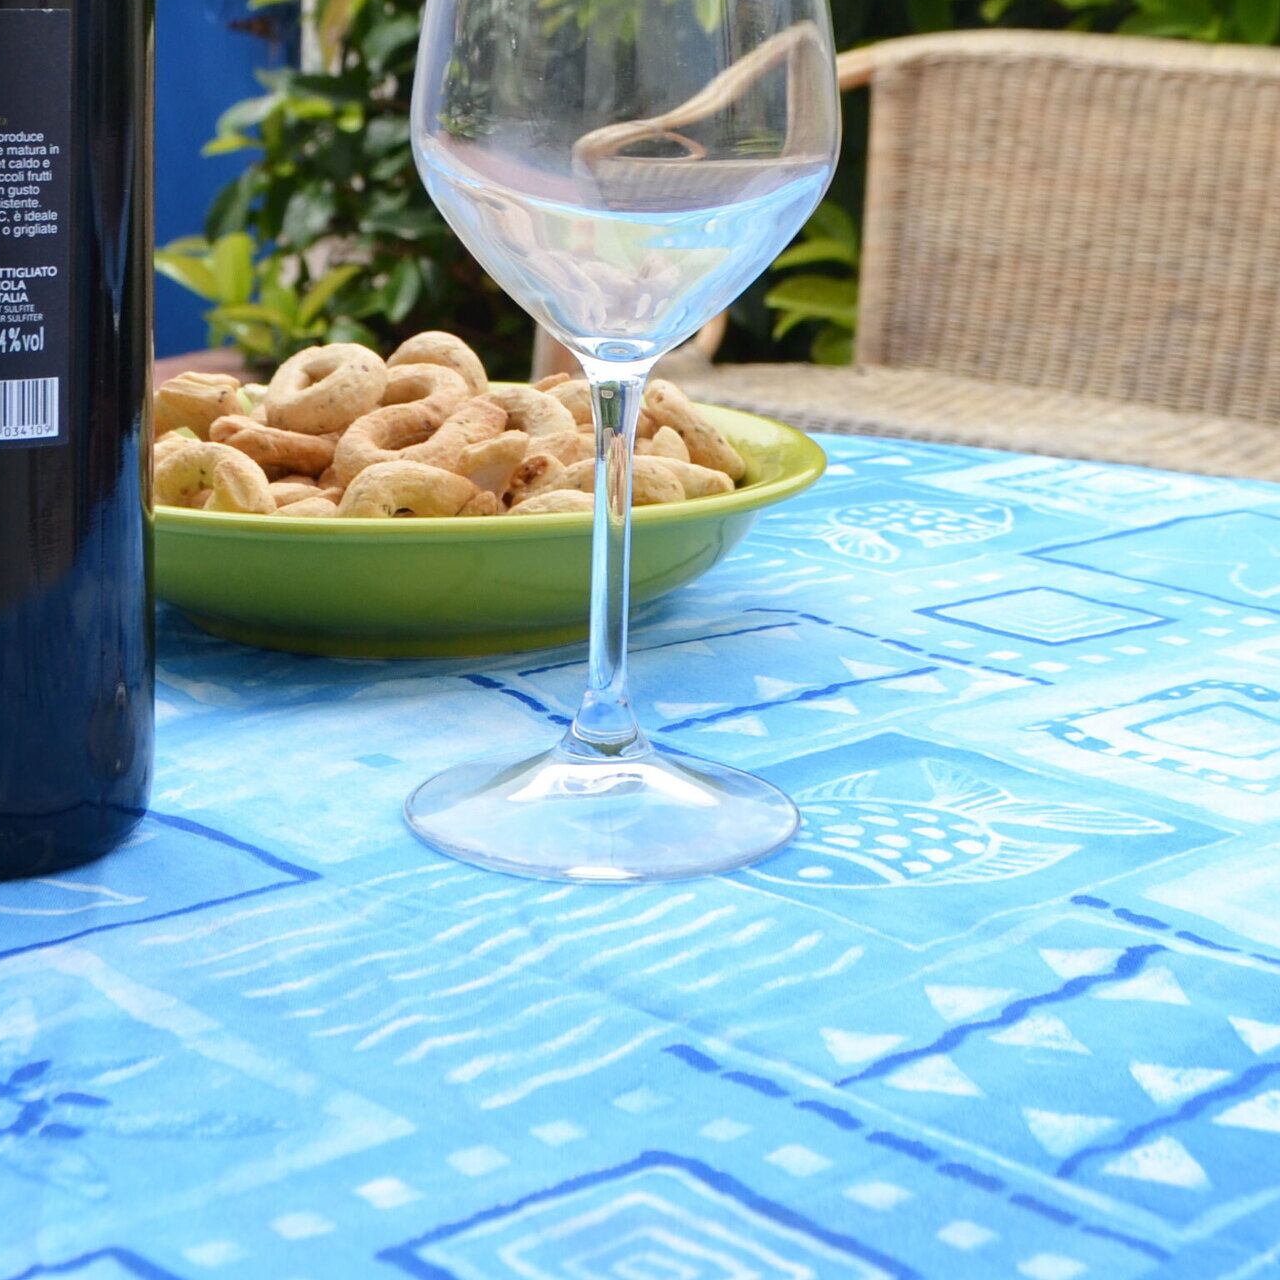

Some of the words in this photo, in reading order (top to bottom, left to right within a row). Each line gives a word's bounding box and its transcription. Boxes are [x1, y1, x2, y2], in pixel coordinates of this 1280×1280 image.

[6, 145, 47, 156] matura
[49, 143, 60, 155] in
[8, 157, 41, 169] caldo
[42, 159, 51, 169] e
[27, 170, 53, 182] frutti
[7, 185, 40, 198] gusto
[13, 210, 21, 222] è
[24, 210, 58, 221] ideale
[2, 226, 11, 236] o
[13, 224, 58, 238] grigliate
[4, 425, 50, 437] 034109
